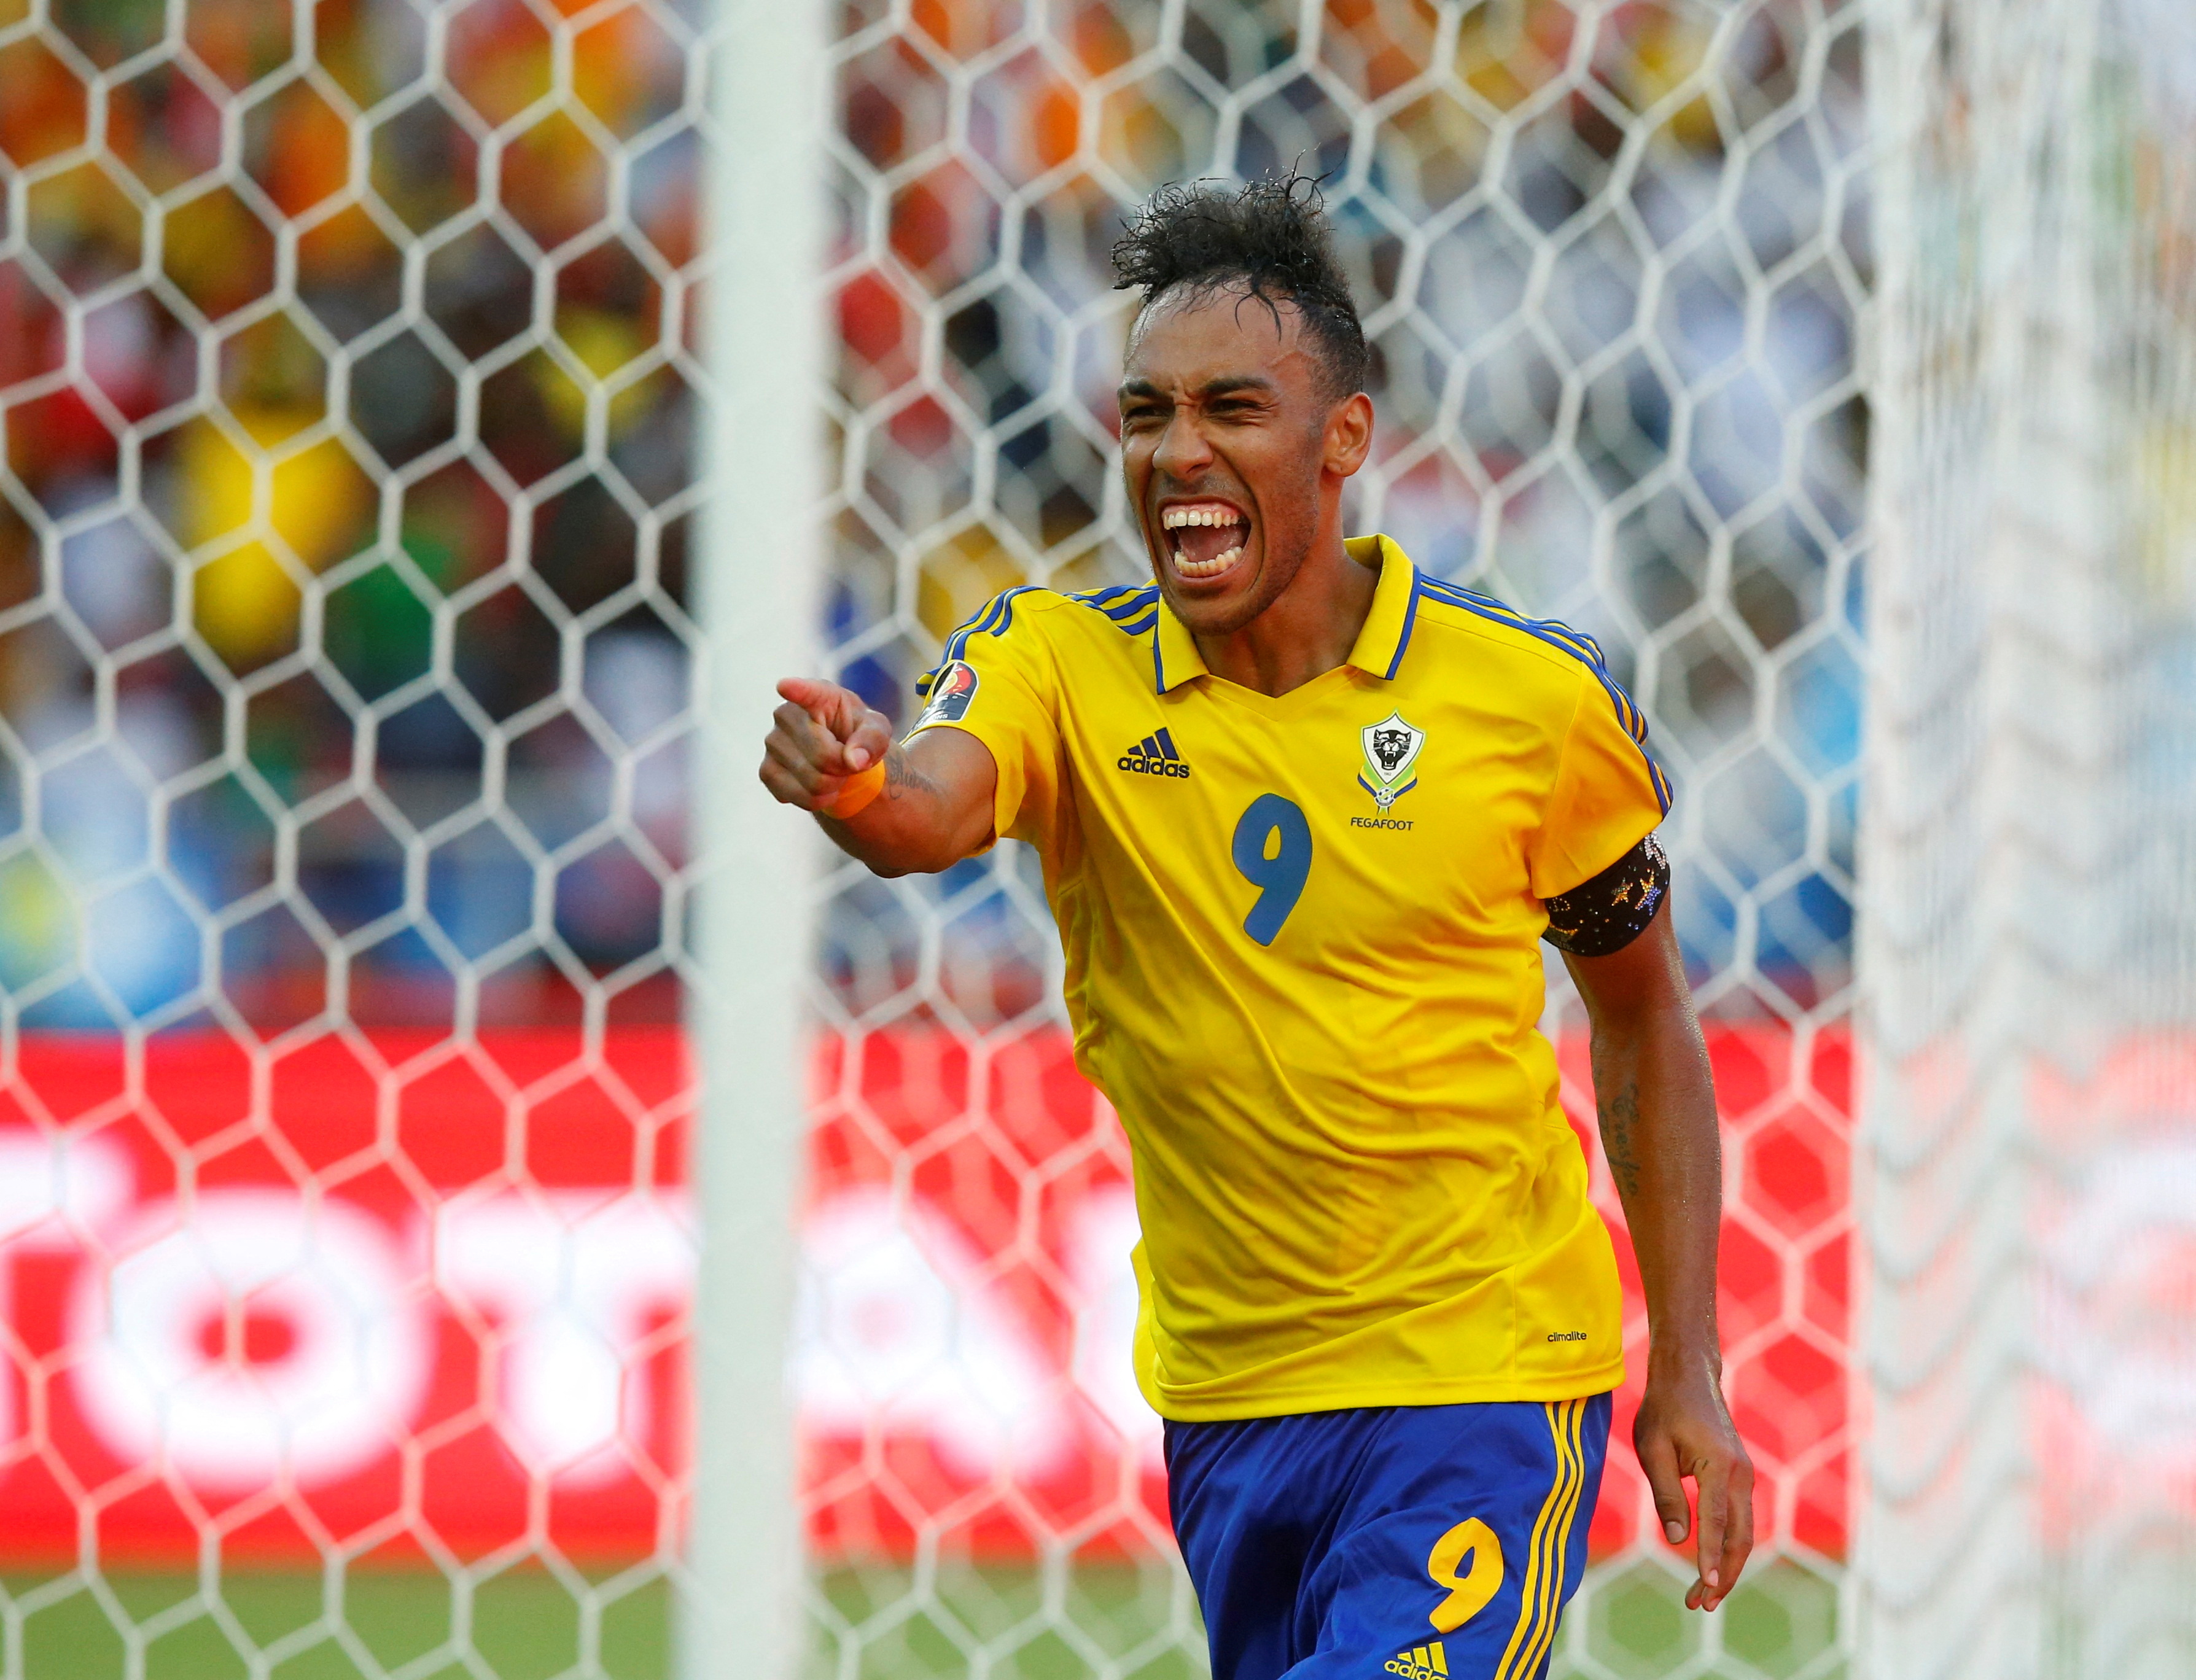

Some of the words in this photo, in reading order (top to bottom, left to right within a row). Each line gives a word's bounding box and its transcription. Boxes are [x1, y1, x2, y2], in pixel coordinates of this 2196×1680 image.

[1117, 755, 1190, 779] adidas
[1350, 817, 1414, 831] FEGAFOOT
[1232, 793, 1312, 946] 9
[1547, 1331, 1587, 1342] climalite
[1428, 1516, 1504, 1634] 9
[1384, 1660, 1446, 1680] adid
